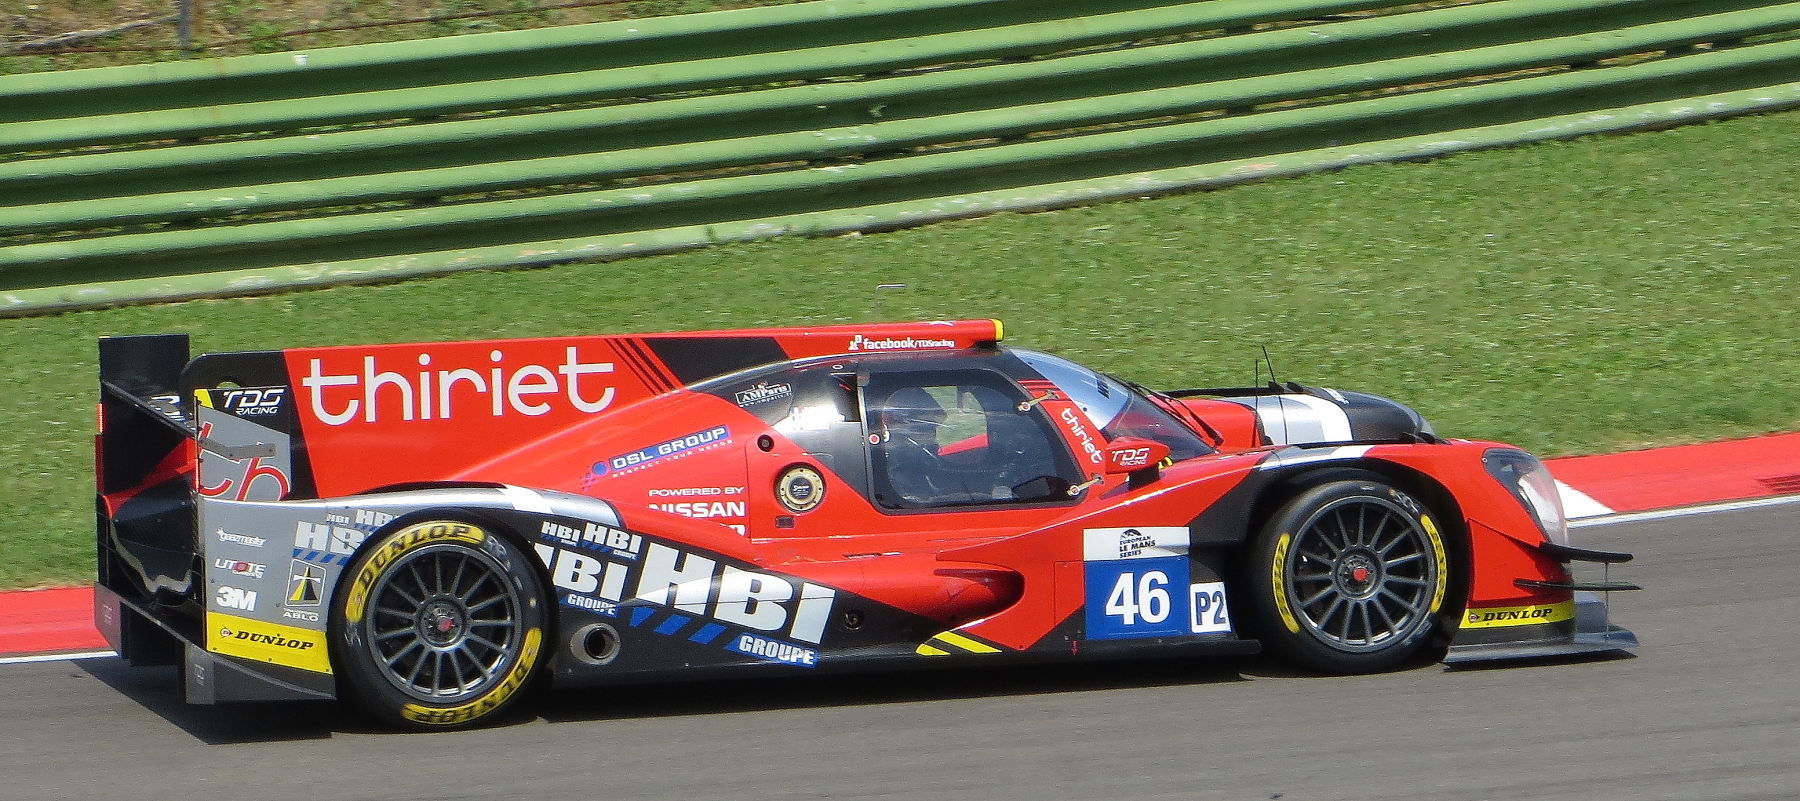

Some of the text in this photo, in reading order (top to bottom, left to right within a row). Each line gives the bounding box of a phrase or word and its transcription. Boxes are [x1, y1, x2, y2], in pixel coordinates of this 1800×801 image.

[302, 346, 615, 426] thiriet
[223, 389, 286, 409] TDS
[235, 406, 279, 416] RACING
[658, 427, 726, 456] GROUP
[1061, 407, 1103, 464] thiriet
[612, 460, 660, 478] RESPECT
[665, 450, 693, 462] YOUR
[1112, 447, 1150, 462] TDS
[648, 486, 745, 497] POWERED BY
[541, 521, 581, 542] HBI
[583, 522, 642, 554] HBI
[1119, 535, 1151, 545] EUROPEAN
[359, 523, 470, 590] DUNLOP
[1119, 540, 1156, 552] LE MANS
[1119, 549, 1142, 559] SERIES
[216, 586, 258, 612] 3M
[567, 593, 617, 616] GROUPE
[636, 541, 836, 645] HBI
[1105, 569, 1171, 626] 46
[282, 611, 320, 622] ABLO
[1195, 590, 1227, 626] P2
[1482, 608, 1553, 622] DUNLOP
[235, 630, 314, 650] DUNLOP
[738, 634, 815, 666] GROUPE
